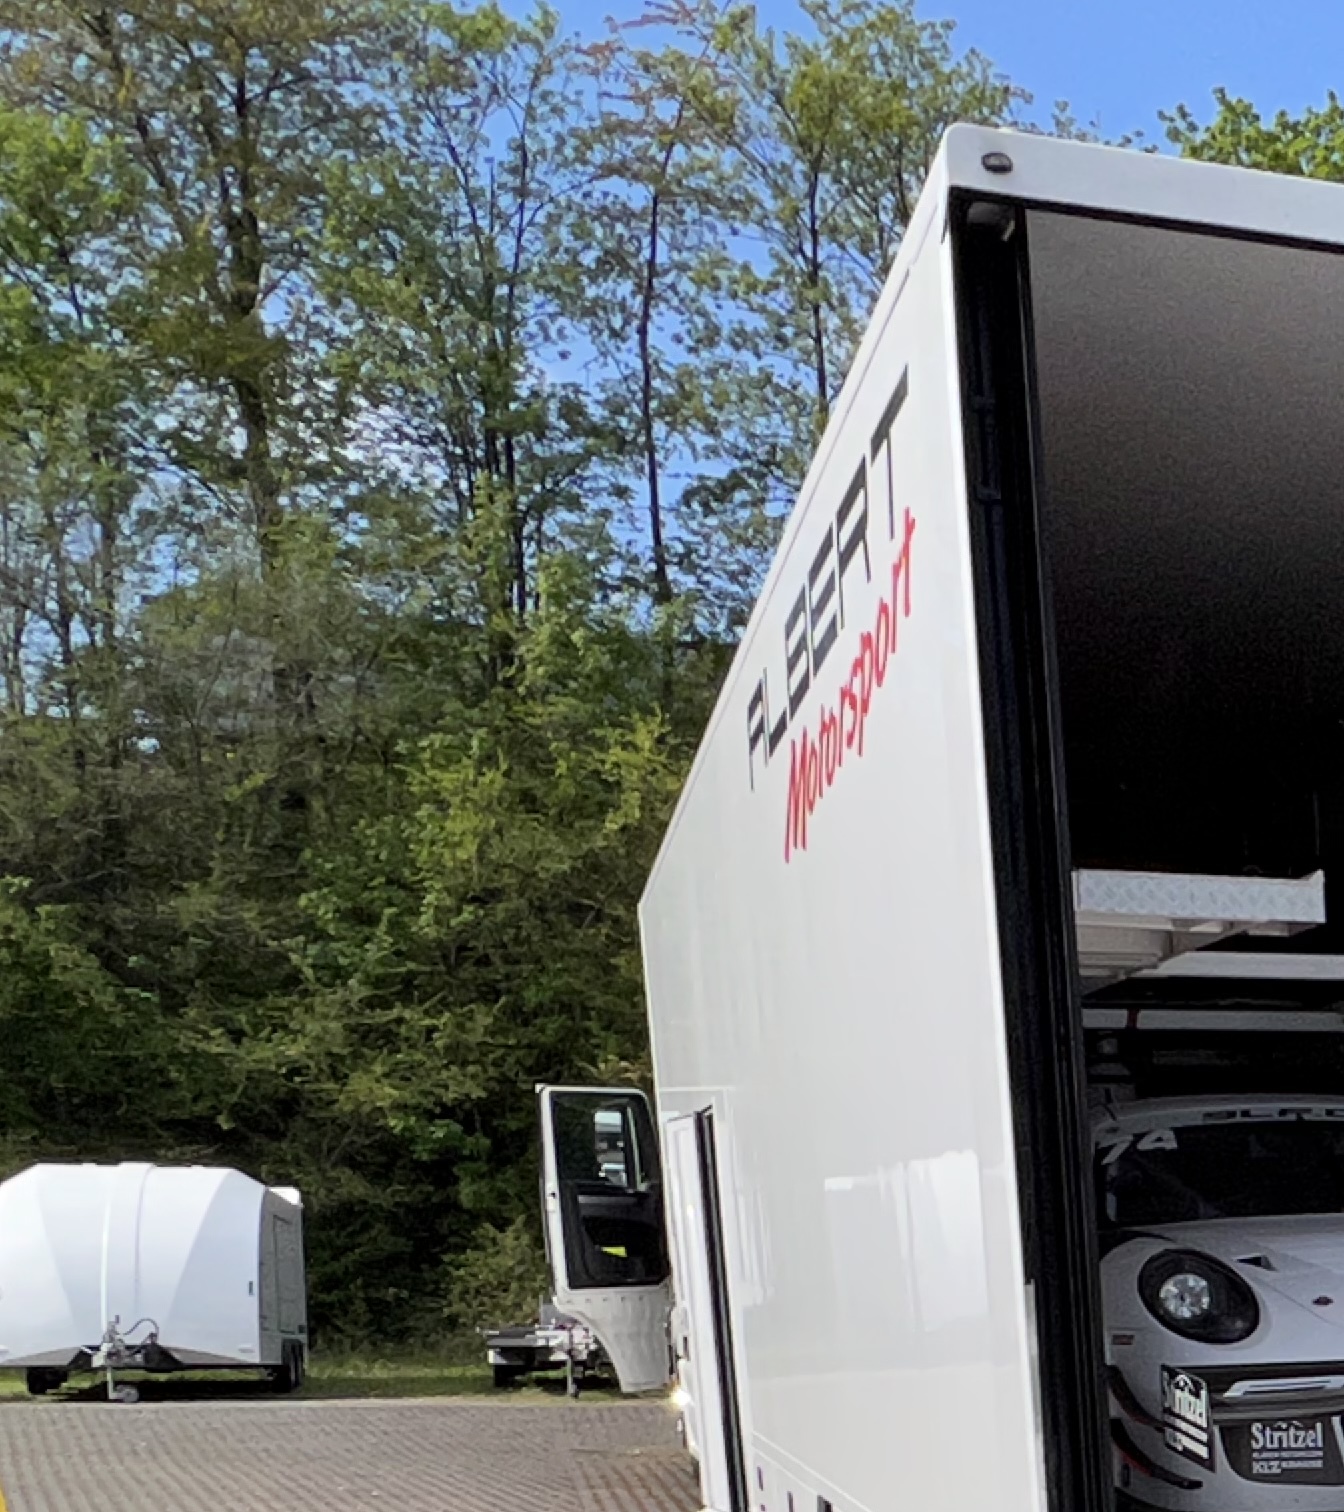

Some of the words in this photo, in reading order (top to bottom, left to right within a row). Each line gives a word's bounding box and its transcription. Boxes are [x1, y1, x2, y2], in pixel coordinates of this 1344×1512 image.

[747, 363, 909, 791] ALBERT
[784, 507, 916, 863] Motorsport
[1250, 1421, 1324, 1450] Stritzel
